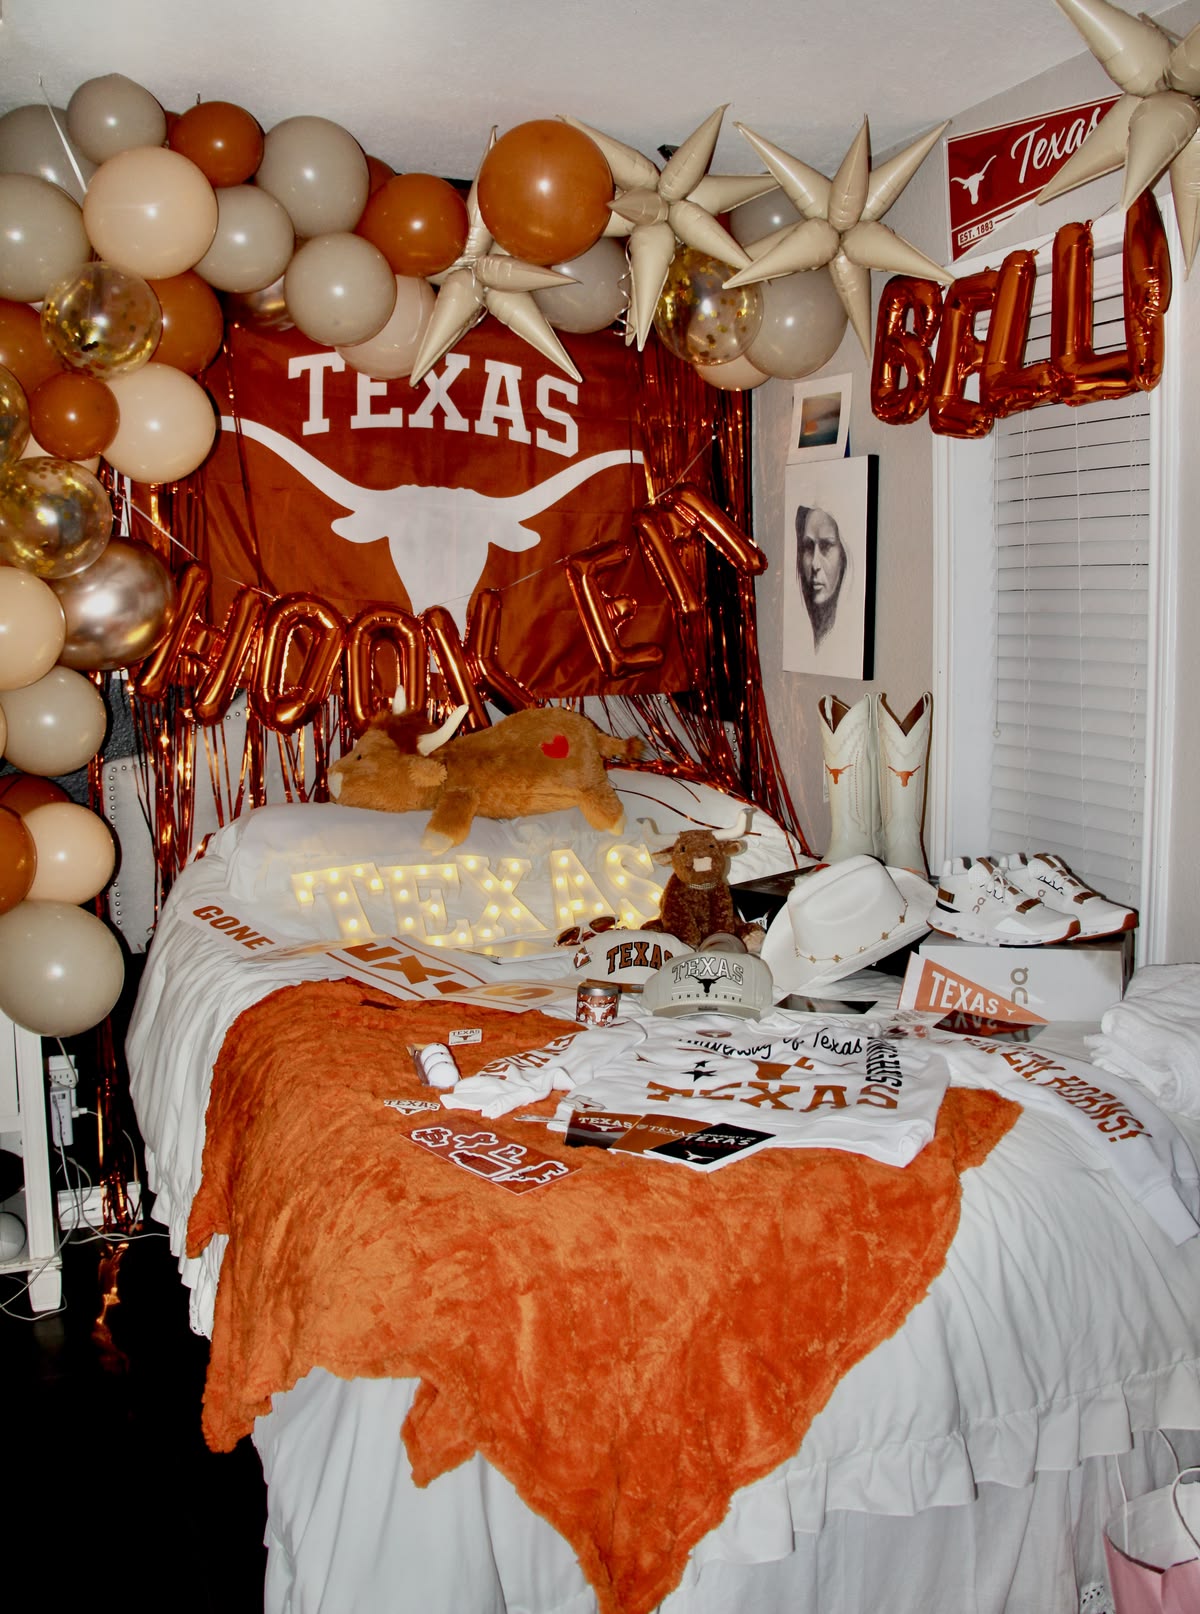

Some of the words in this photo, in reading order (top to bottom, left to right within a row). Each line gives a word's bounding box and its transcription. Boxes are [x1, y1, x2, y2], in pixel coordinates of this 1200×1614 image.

[959, 230, 975, 243] EST.
[977, 220, 994, 235] 1883
[288, 351, 579, 458] TEXAS
[133, 559, 544, 740] HOOK
[291, 845, 664, 947] TEXAS
[192, 905, 275, 951] GONE
[671, 956, 744, 986] TEXAS
[928, 970, 1000, 1015] TEXAS
[384, 1100, 439, 1110] TEXAS
[579, 1117, 633, 1129] TEXAS
[649, 1125, 687, 1137] TEXA
[683, 1134, 751, 1146] TEXAS
